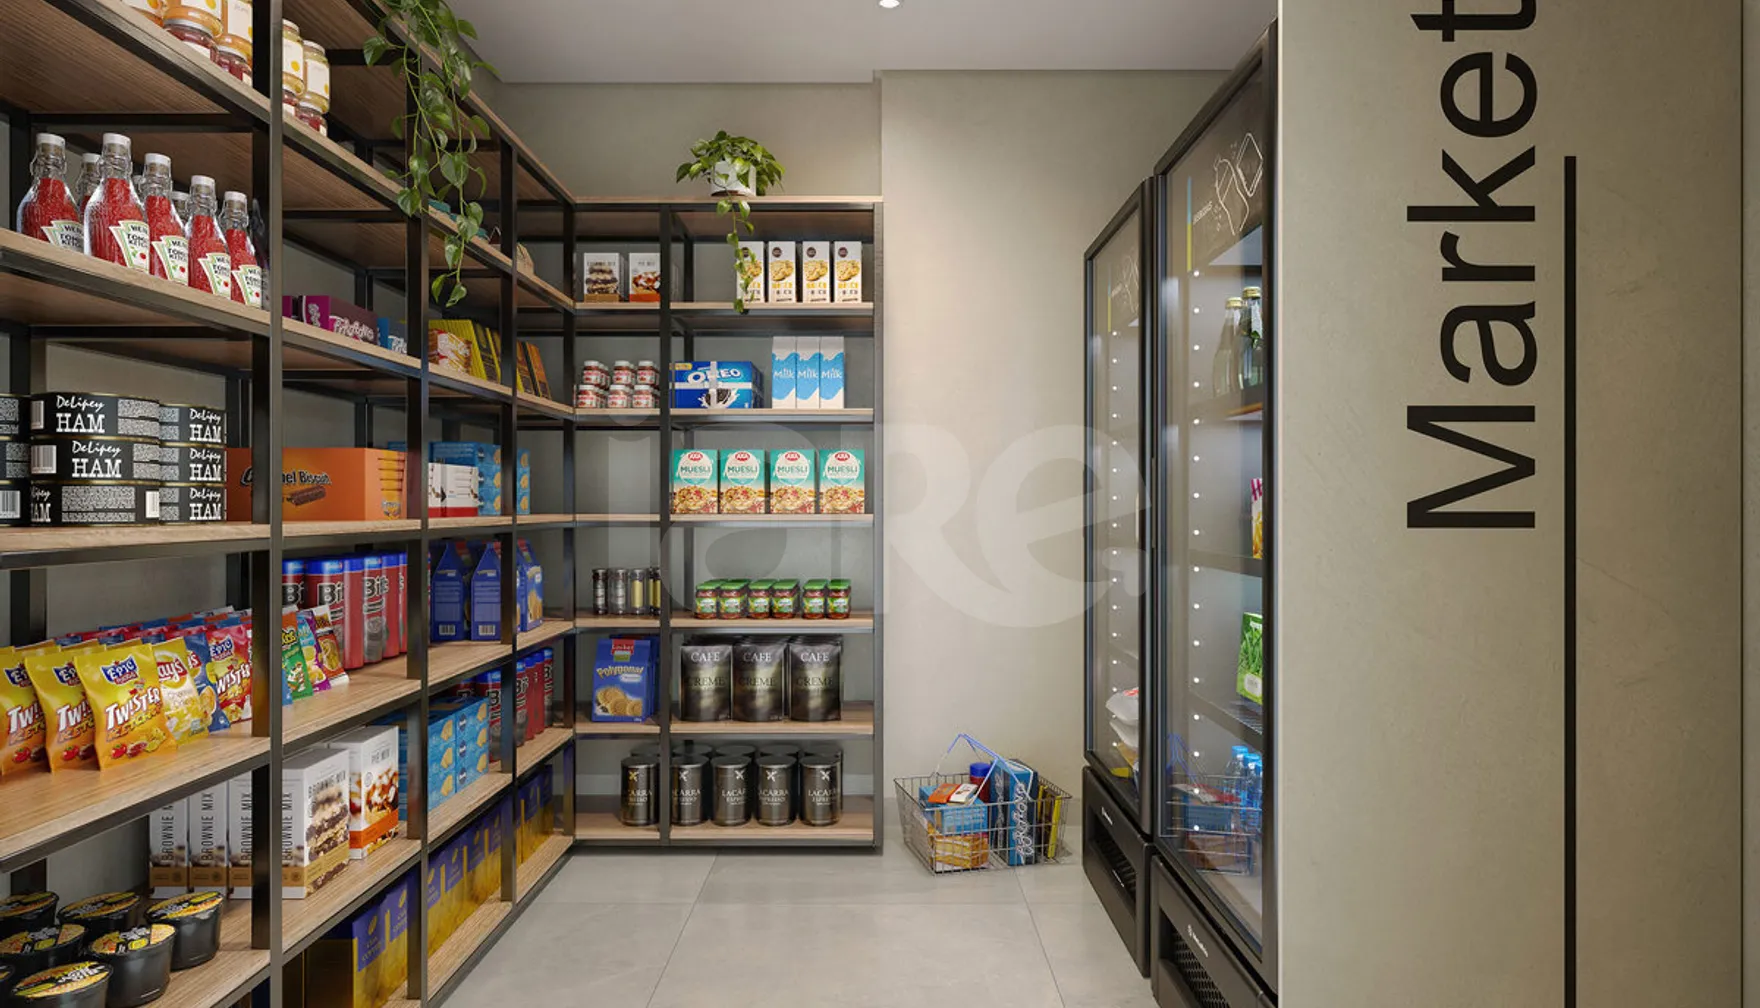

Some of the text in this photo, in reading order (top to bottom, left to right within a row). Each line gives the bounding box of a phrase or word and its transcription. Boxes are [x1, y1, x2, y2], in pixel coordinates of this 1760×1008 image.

[1407, 0, 1537, 528] Market
[773, 368, 795, 379] Milk
[797, 368, 818, 379] Milk
[821, 368, 843, 379] Milk
[56, 413, 105, 433] HAM
[189, 424, 222, 443] HAM
[72, 458, 122, 478] HAM
[189, 464, 222, 481] HAM
[681, 465, 710, 474] MUESLI
[727, 465, 757, 474] MUESLI
[777, 465, 807, 474] MUESLI
[827, 465, 857, 474] MUESLI
[189, 503, 222, 520] HAM
[201, 792, 214, 861] BROWNIE MIX
